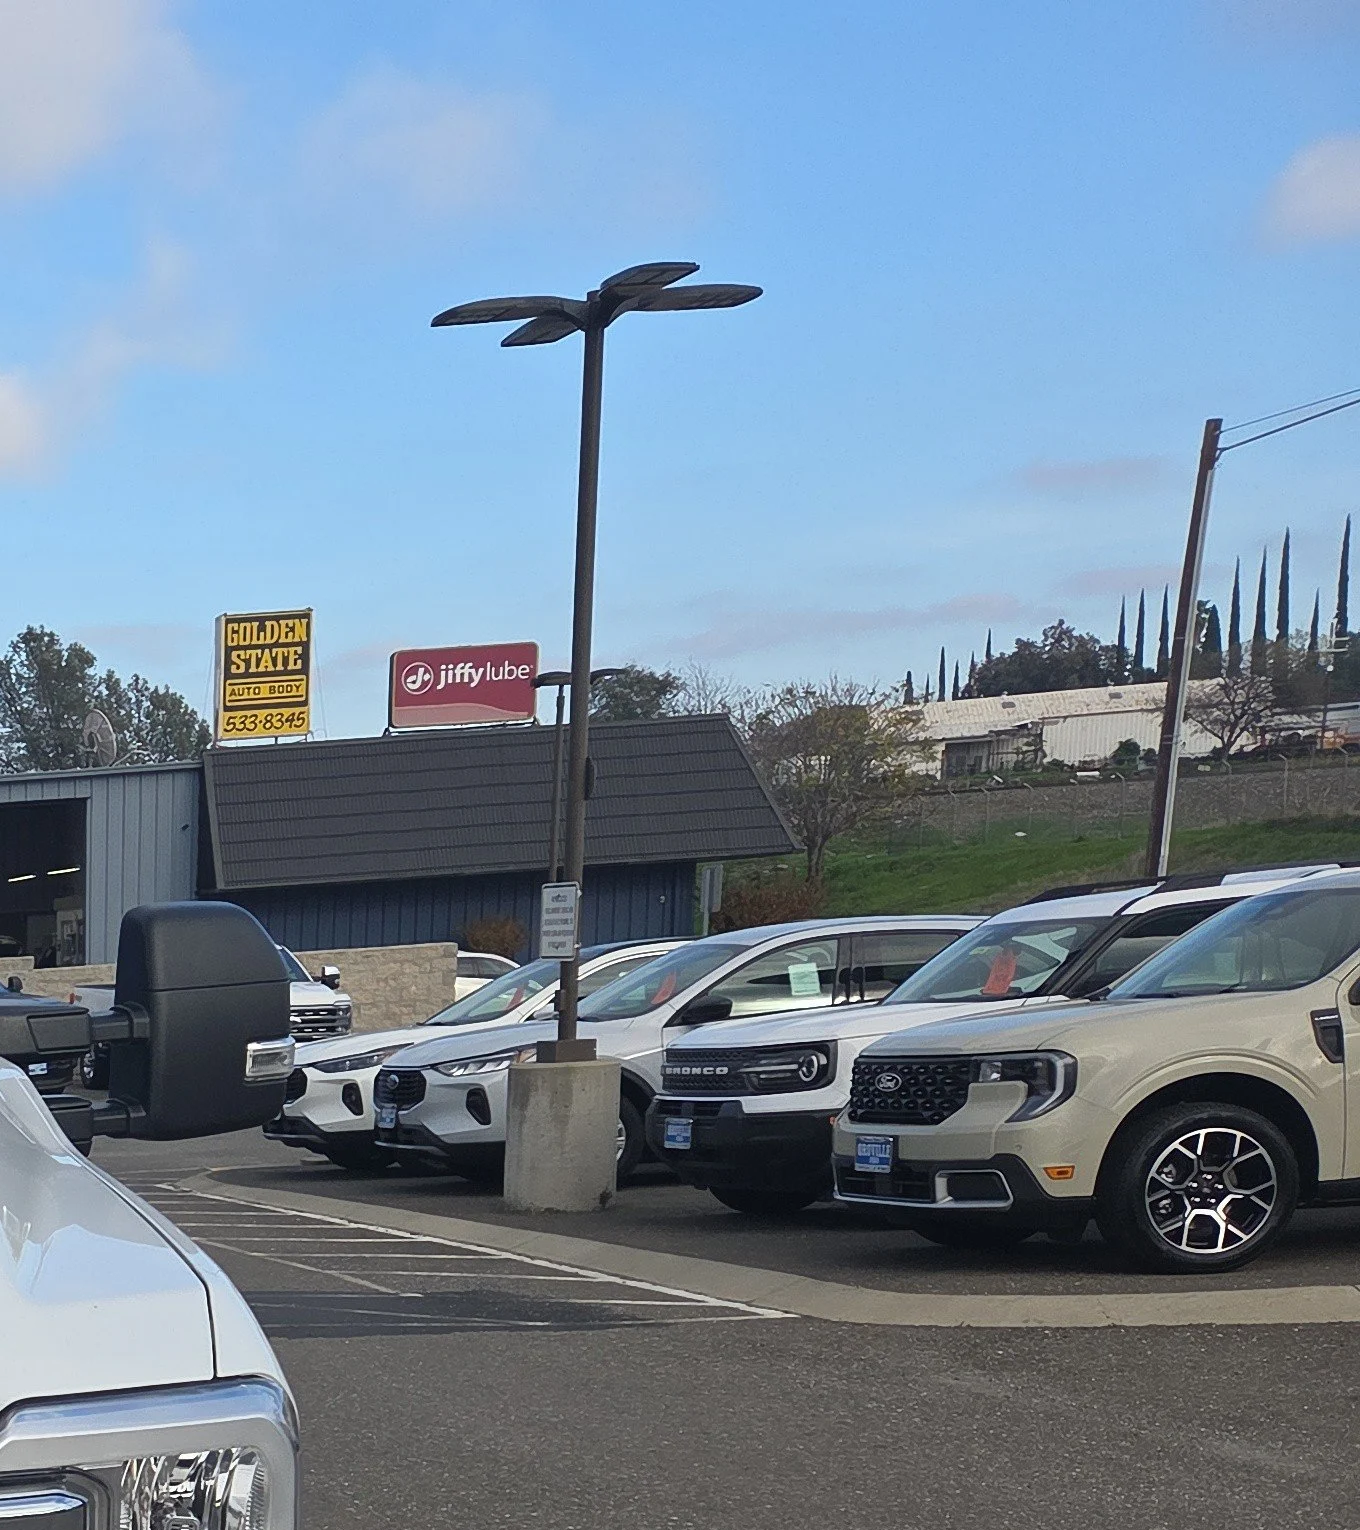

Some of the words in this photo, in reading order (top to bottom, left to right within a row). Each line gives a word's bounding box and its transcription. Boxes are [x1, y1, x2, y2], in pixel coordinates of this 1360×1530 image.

[227, 619, 309, 646] GOLDEN
[230, 646, 302, 674] STATE
[229, 686, 261, 697] AUTO
[269, 683, 303, 694] BODY
[665, 1066, 729, 1075] BRONCO
